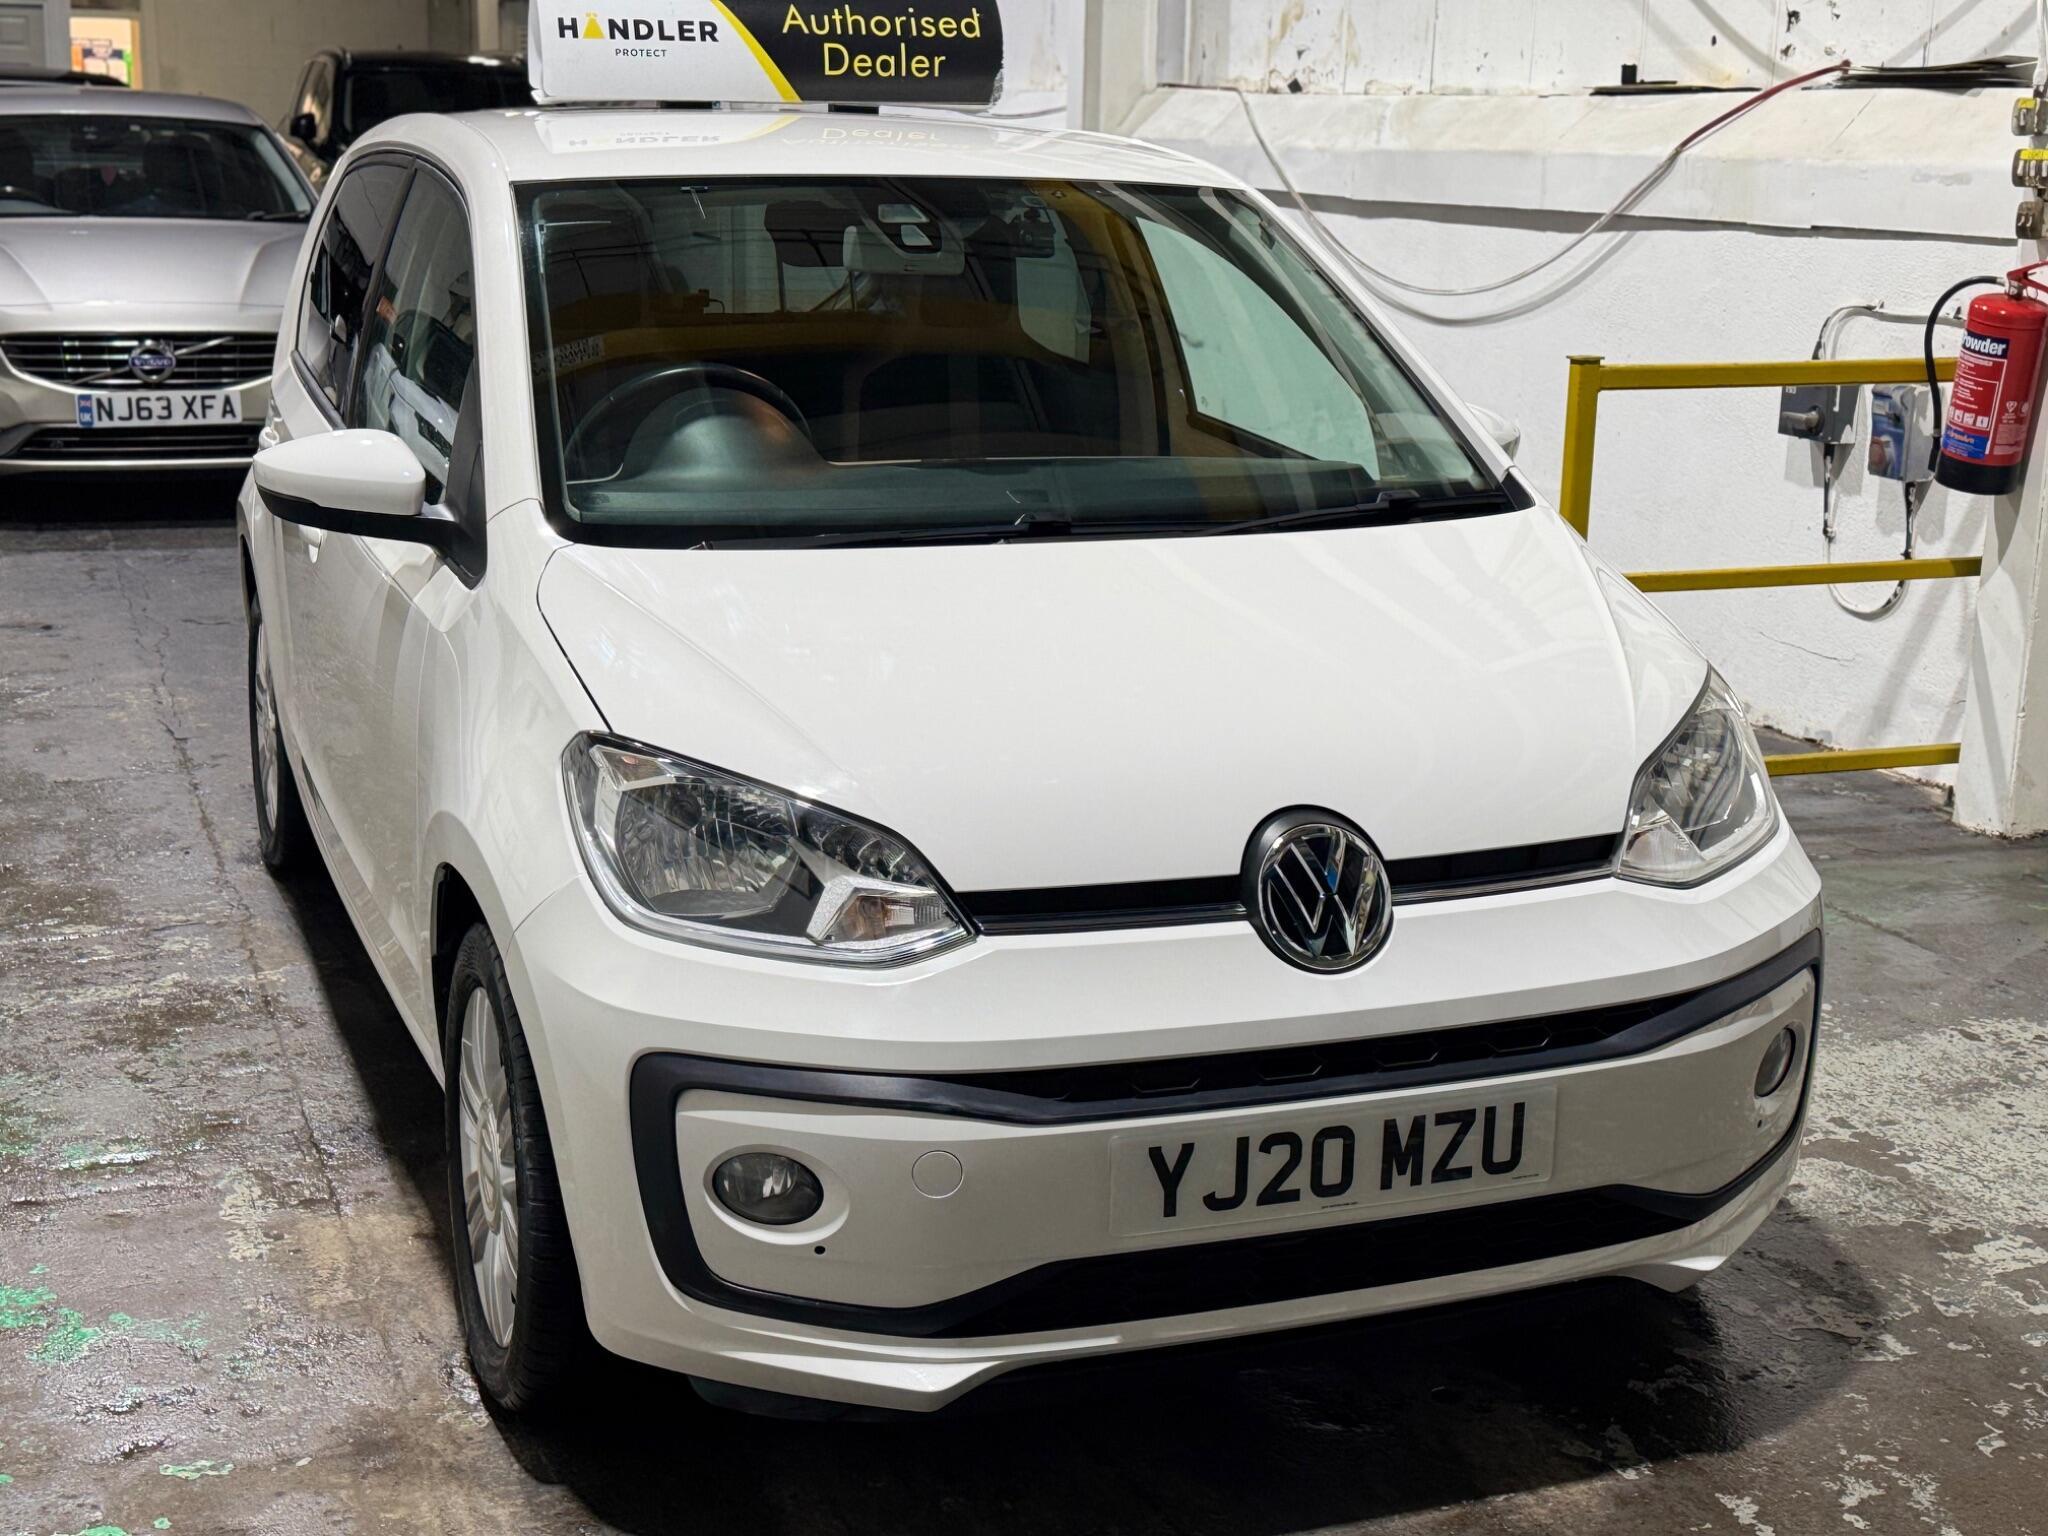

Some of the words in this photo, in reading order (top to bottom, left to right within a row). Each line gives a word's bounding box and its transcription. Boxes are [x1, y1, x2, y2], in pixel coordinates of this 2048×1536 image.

[782, 4, 982, 38] Authorised
[615, 48, 667, 57] PROTECT
[823, 42, 946, 77] Dealer
[80, 412, 93, 423] UK
[95, 396, 173, 421] NJ63
[181, 394, 236, 419] XFA
[1148, 1124, 1356, 1218] YJ20
[1379, 1101, 1526, 1190] MZU
